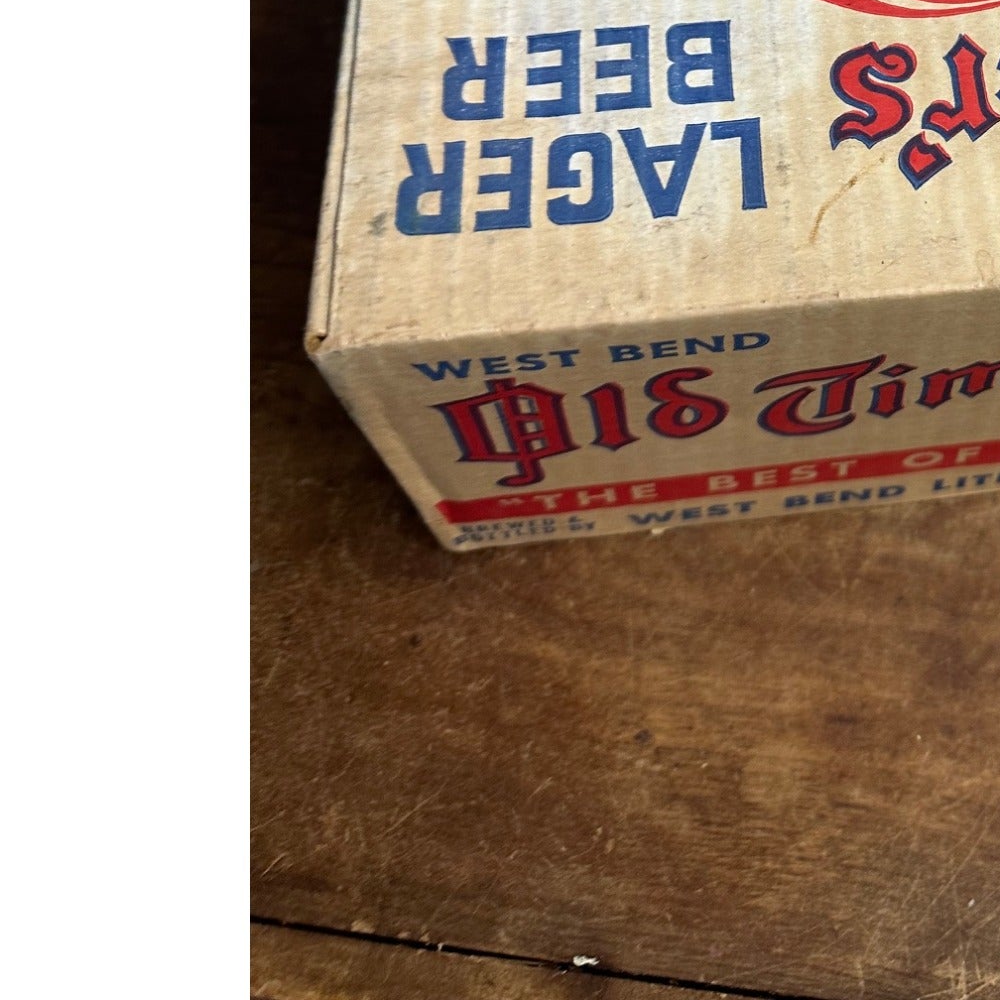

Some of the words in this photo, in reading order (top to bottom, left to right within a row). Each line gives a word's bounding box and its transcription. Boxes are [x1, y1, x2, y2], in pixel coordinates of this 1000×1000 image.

[442, 19, 736, 121] BEER
[395, 116, 768, 236] LAGER
[411, 348, 581, 382] WEST
[608, 331, 772, 364] BEND
[429, 366, 730, 487] Old
[499, 482, 659, 511] "THE
[707, 459, 859, 492] BEST
[901, 445, 983, 468] OF
[627, 499, 757, 525] WEST
[784, 485, 907, 509] BEND
